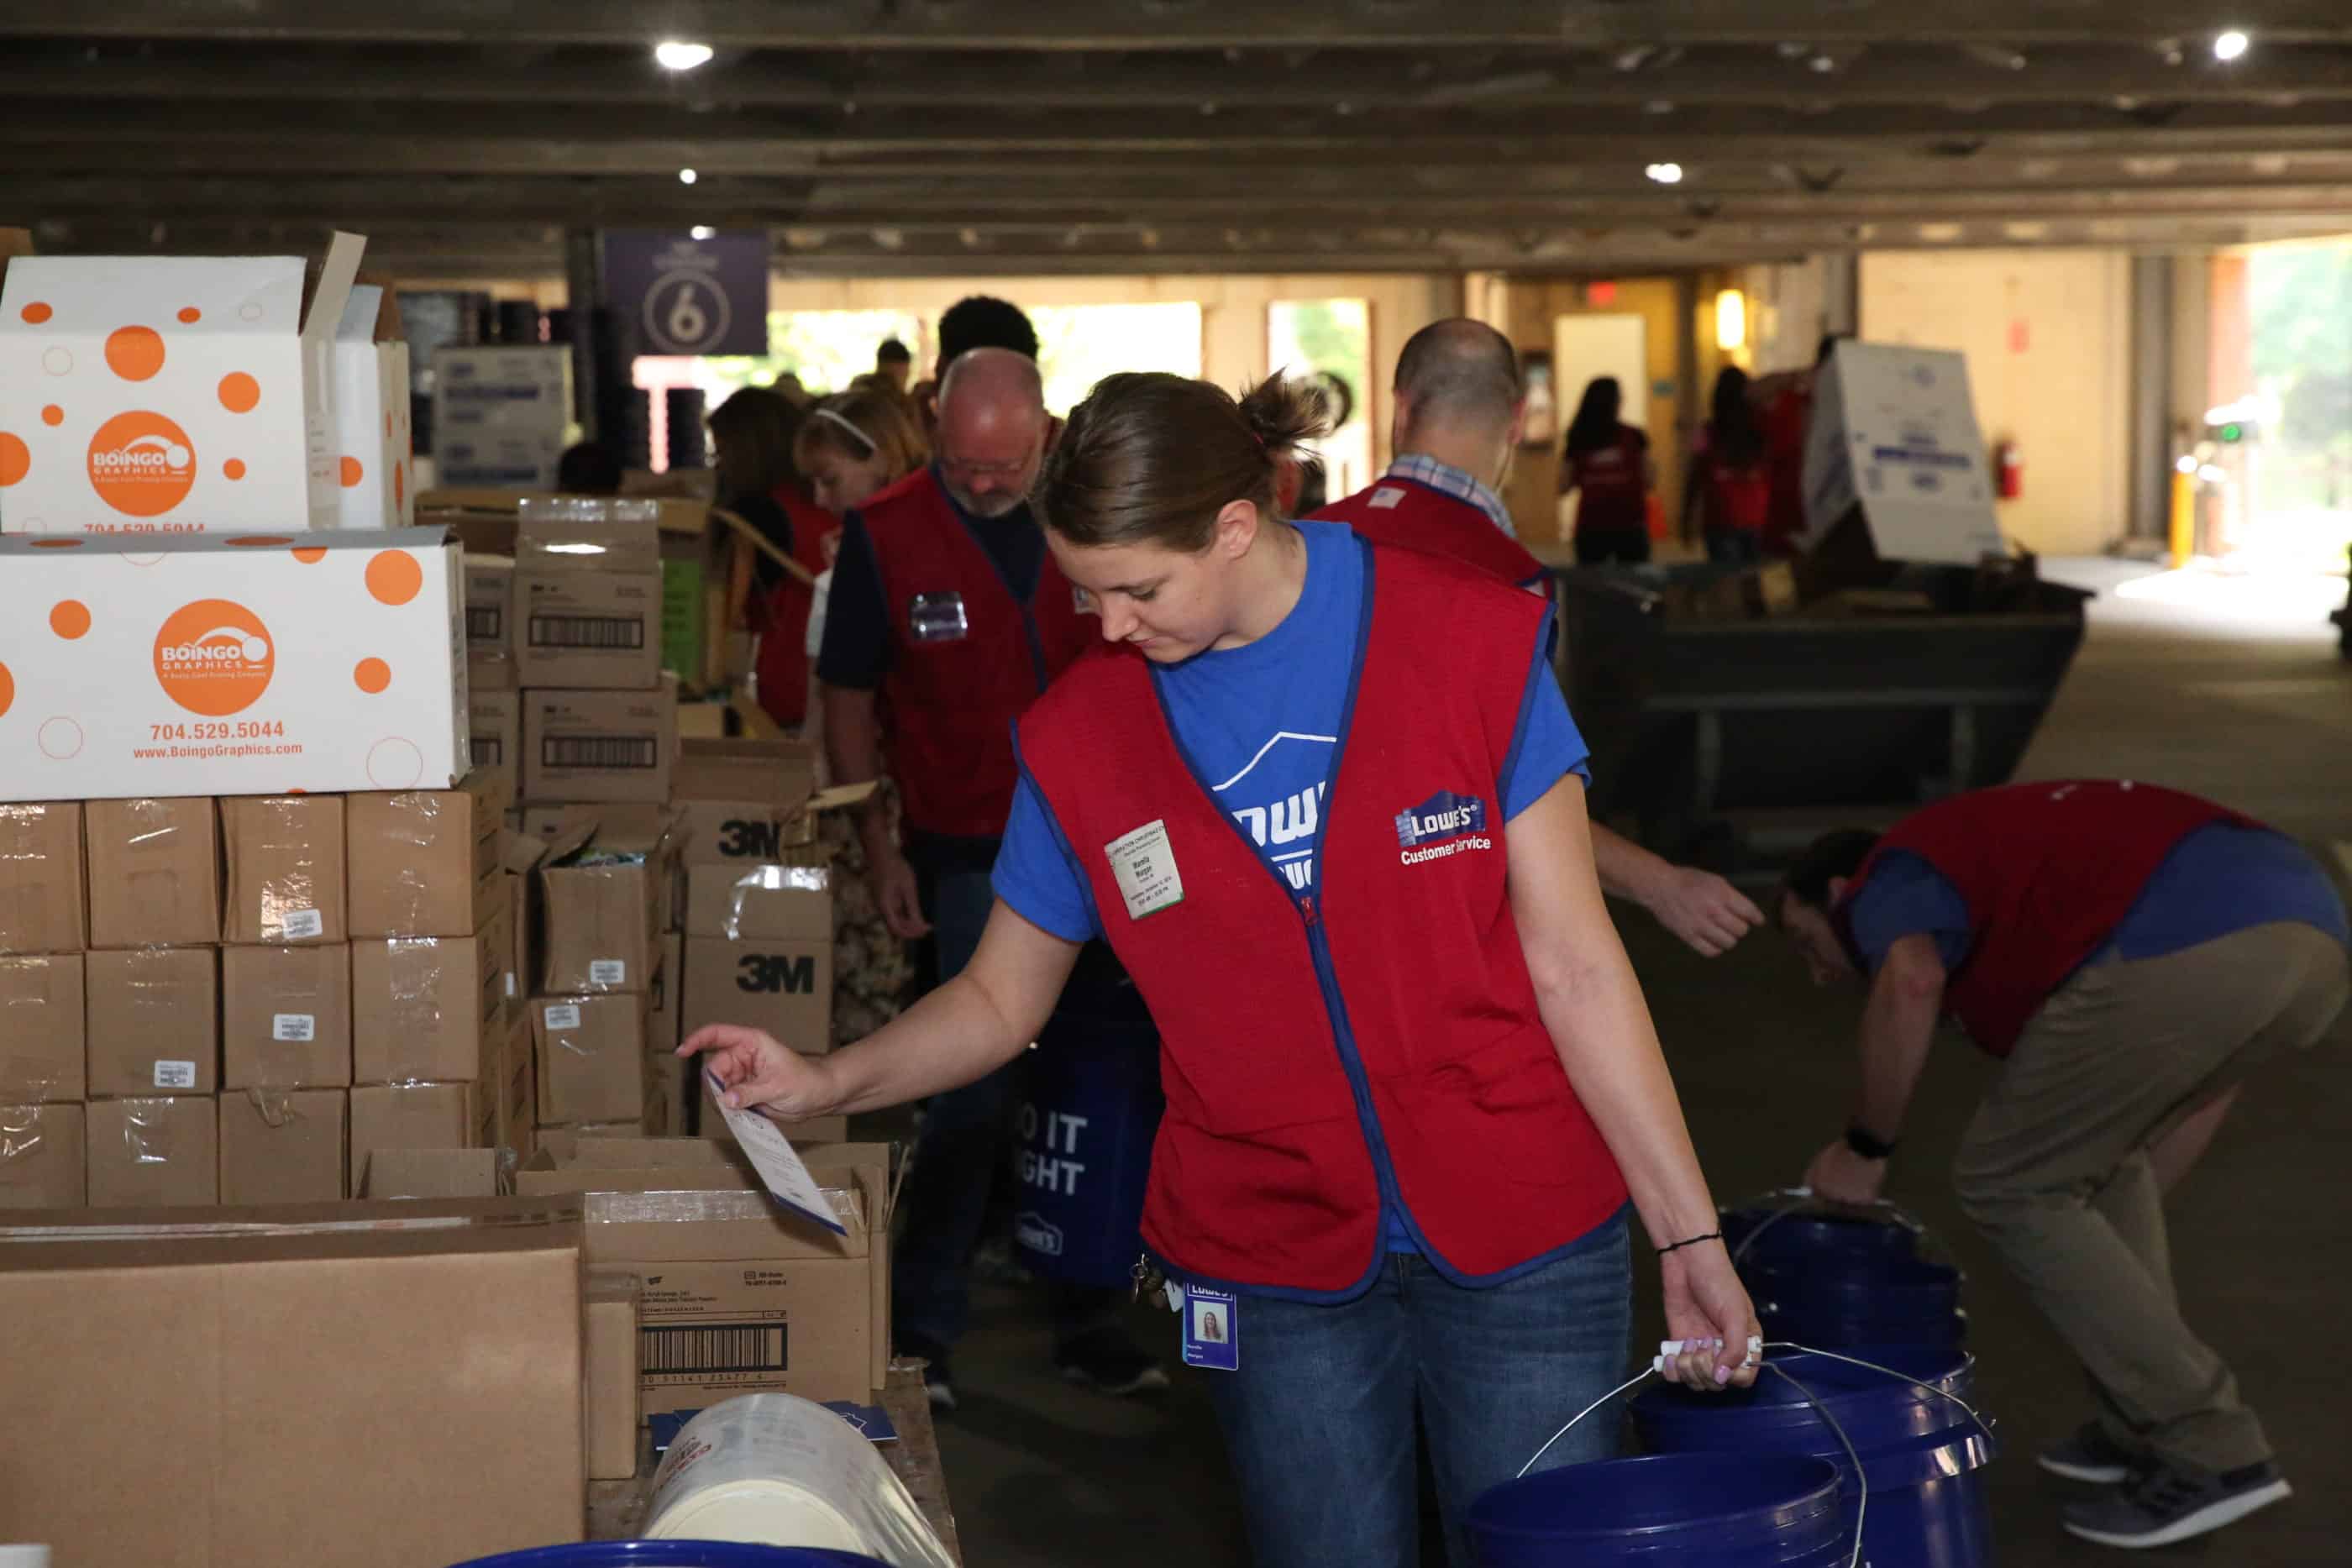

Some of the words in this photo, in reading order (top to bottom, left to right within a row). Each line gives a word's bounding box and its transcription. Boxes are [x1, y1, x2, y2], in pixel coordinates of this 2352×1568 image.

[669, 282, 708, 343] 6
[134, 744, 303, 759] www.BoingoGraphics.com
[150, 720, 285, 741] 704.529.5044
[1400, 842, 1455, 866] Customer
[1456, 835, 1491, 853] ervice
[736, 953, 815, 995] 3M
[1046, 1109, 1089, 1155] IT
[1021, 1149, 1086, 1197] GHT
